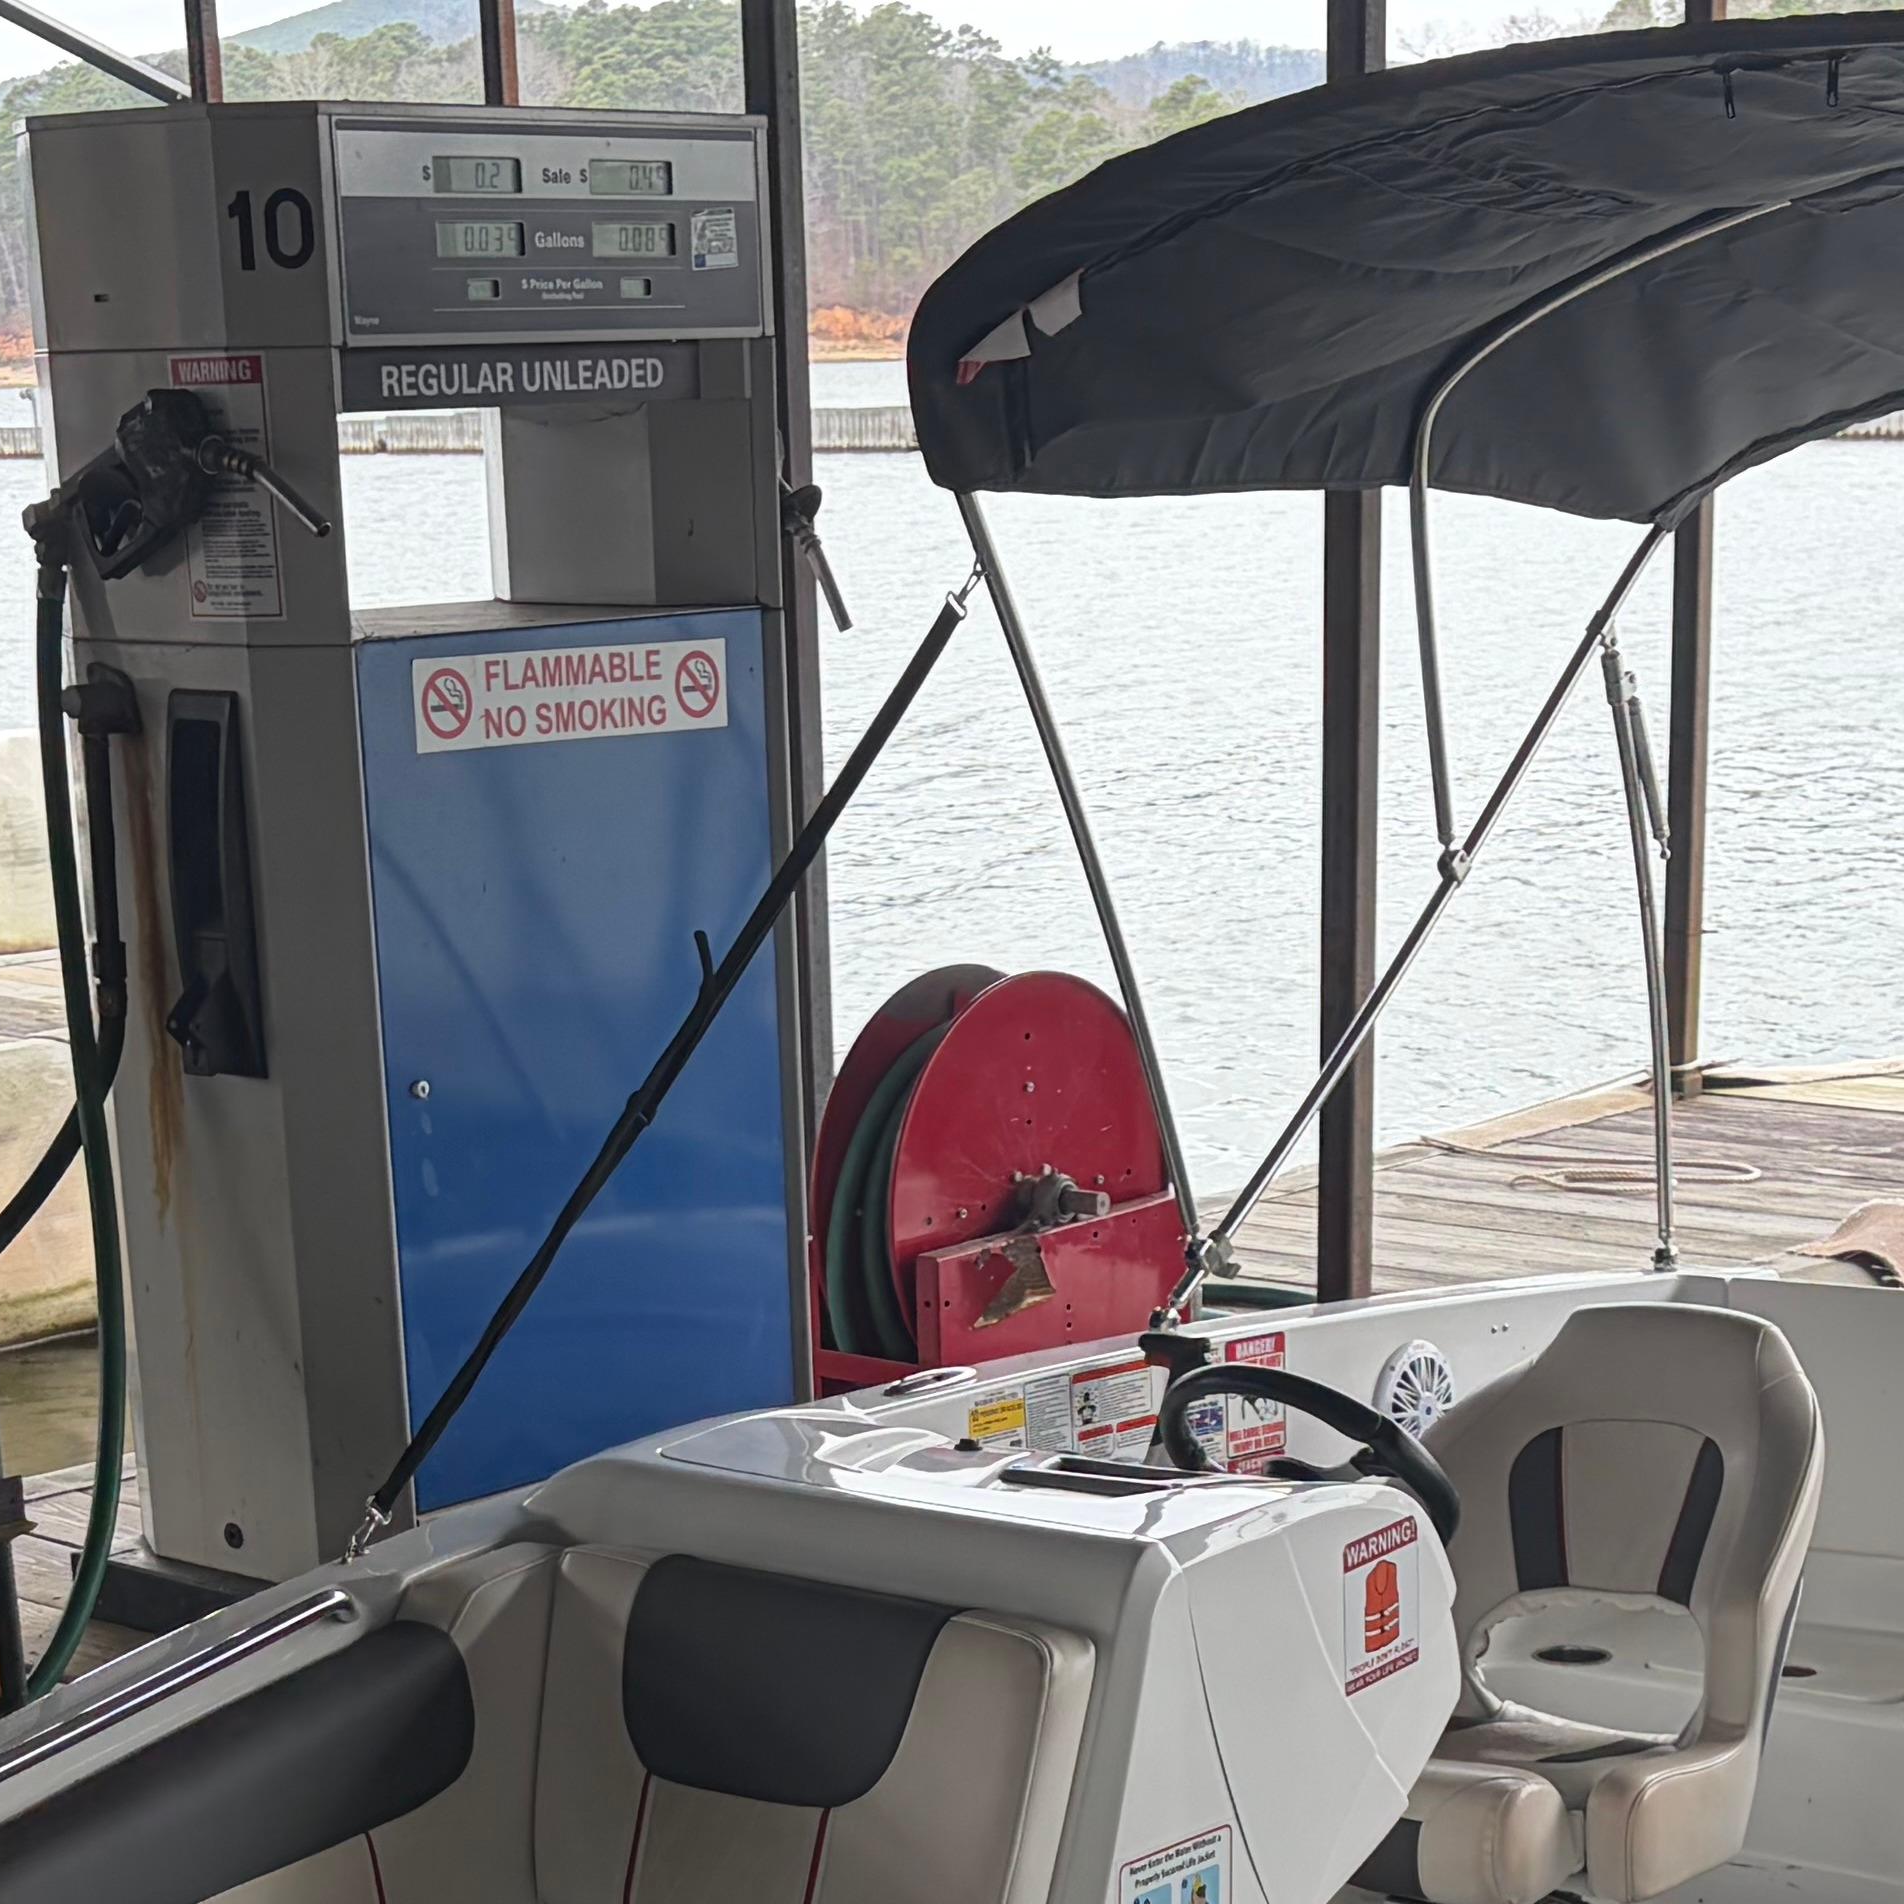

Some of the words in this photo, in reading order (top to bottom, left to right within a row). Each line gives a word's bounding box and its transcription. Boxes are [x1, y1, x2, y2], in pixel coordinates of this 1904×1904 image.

[542, 168, 571, 184] Sale
[228, 187, 315, 271] 10
[534, 232, 585, 249] Gallons
[178, 359, 252, 382] WARNING
[381, 362, 515, 397] REGULAR
[522, 357, 664, 392] UNLEADED
[484, 649, 663, 692] FLAMMABLE
[483, 704, 527, 739] NO
[535, 694, 667, 735] SMOKING
[1346, 1519, 1416, 1567] WARNING!
